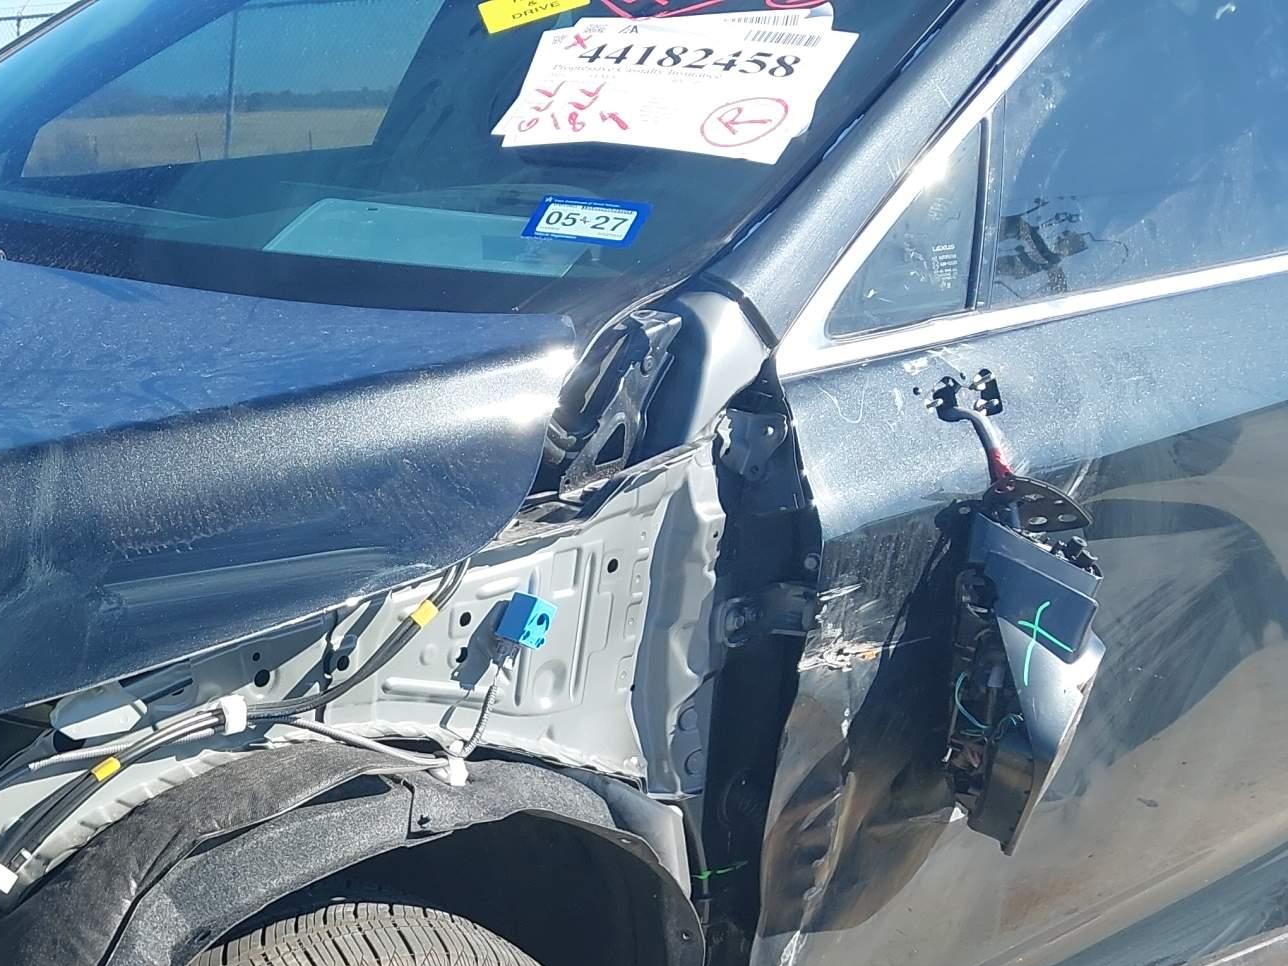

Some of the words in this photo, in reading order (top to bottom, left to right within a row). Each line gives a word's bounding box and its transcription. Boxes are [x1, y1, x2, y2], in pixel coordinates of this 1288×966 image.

[511, 1, 560, 20] DRIVE
[578, 42, 801, 78] 44182458
[545, 211, 580, 227] 05
[590, 215, 629, 232] 27
